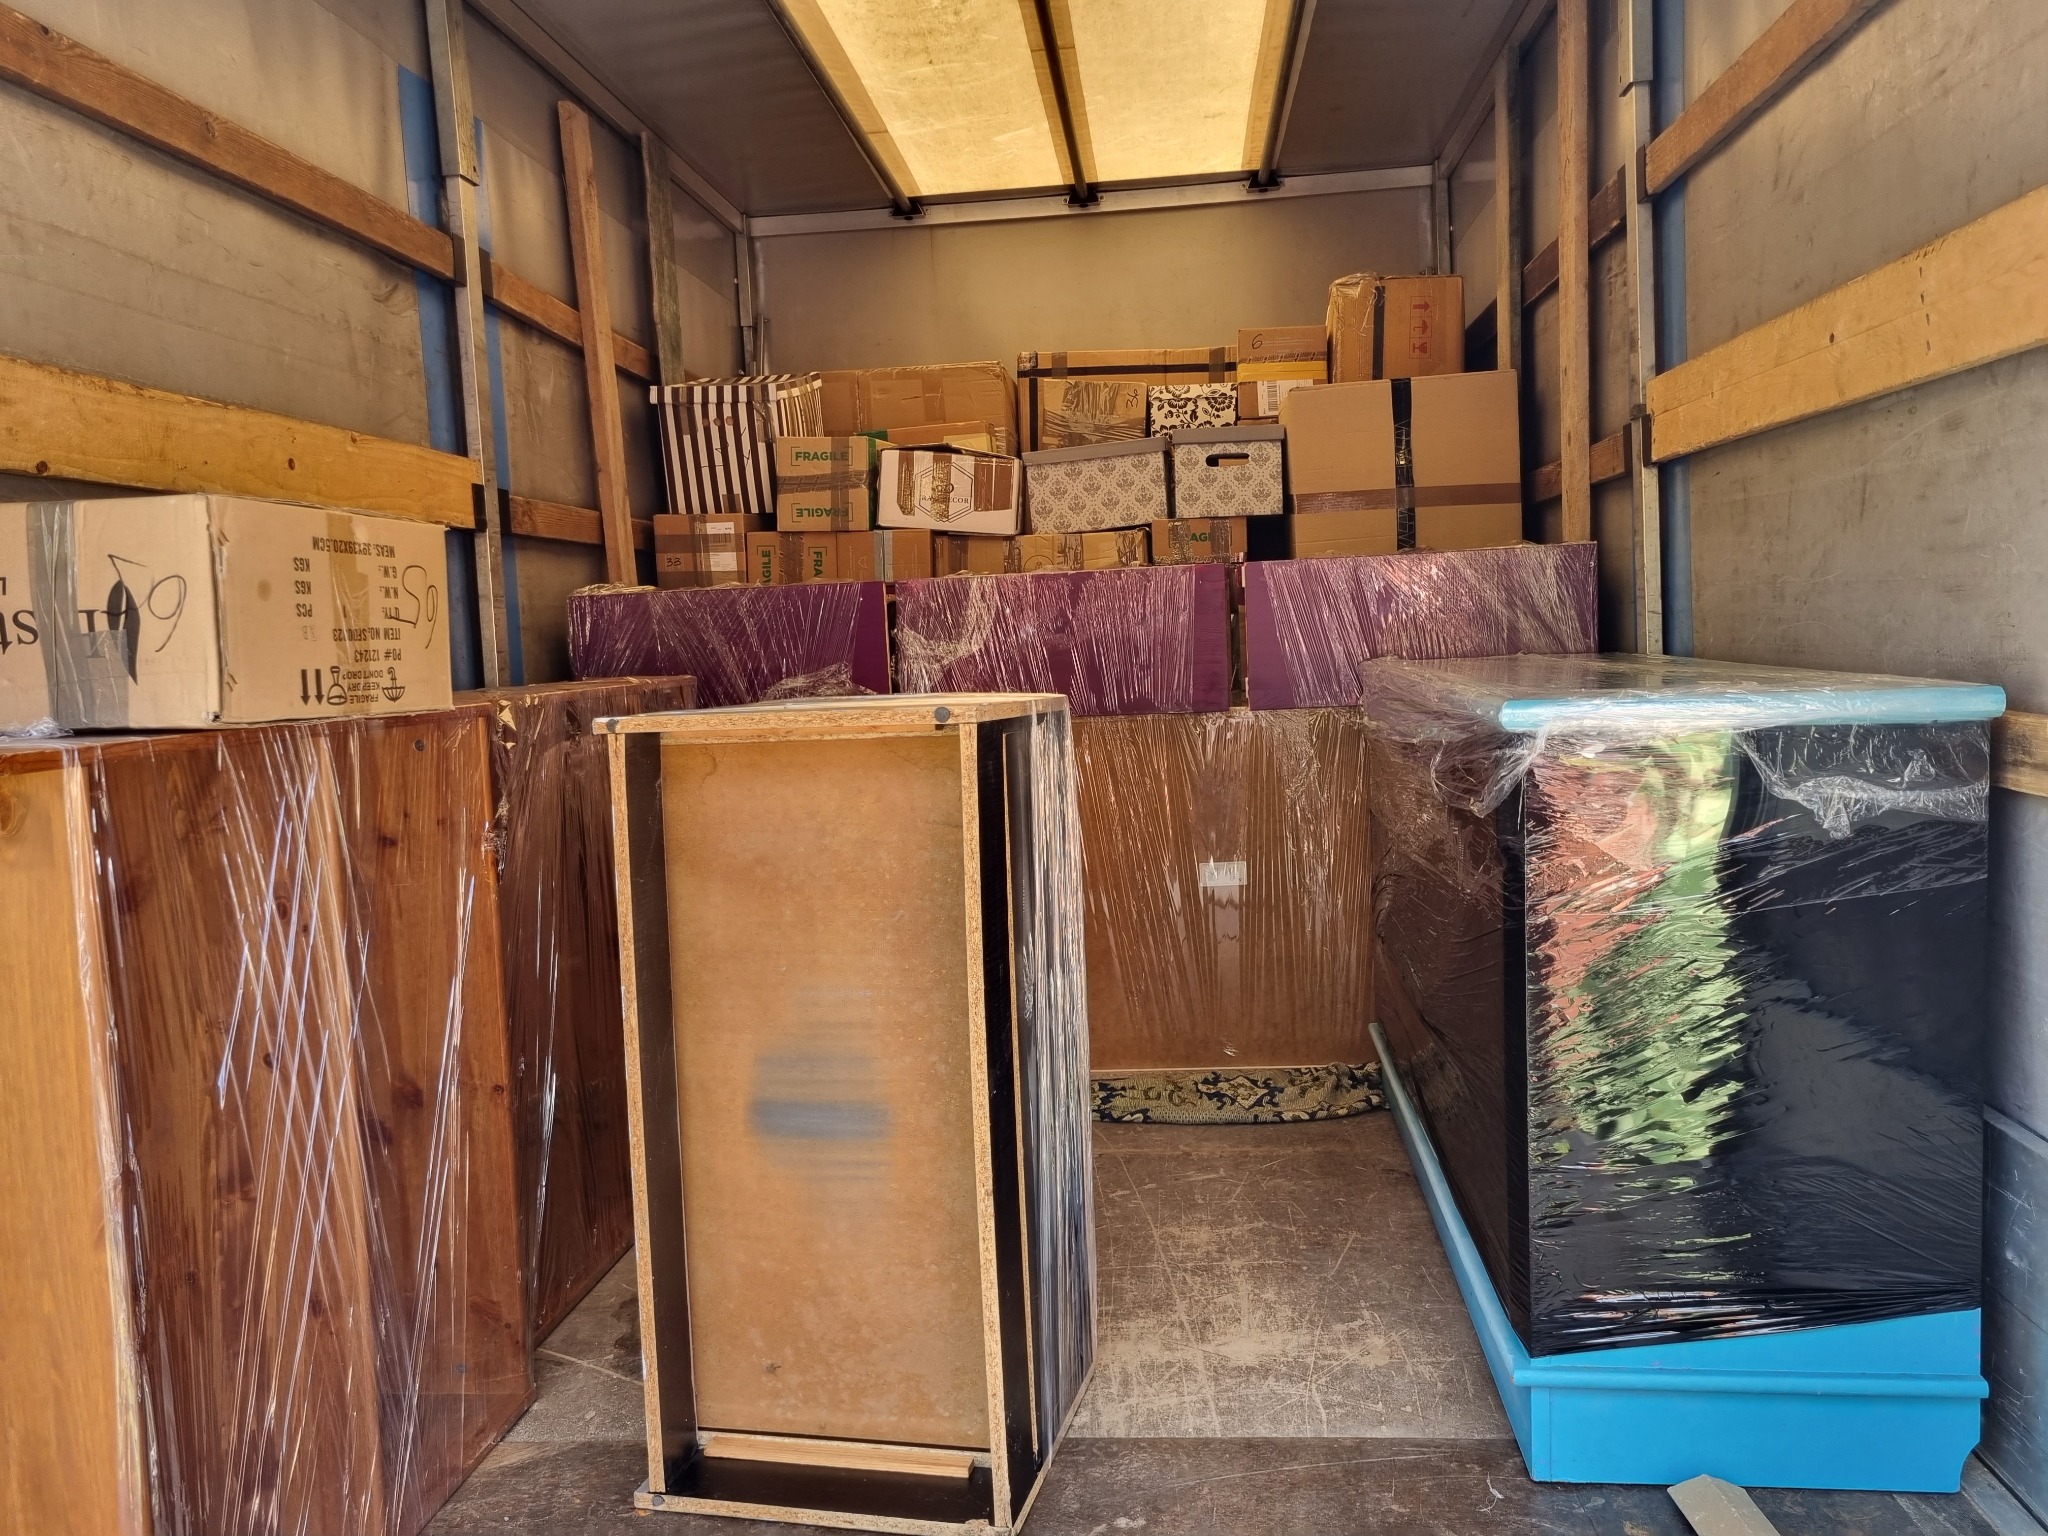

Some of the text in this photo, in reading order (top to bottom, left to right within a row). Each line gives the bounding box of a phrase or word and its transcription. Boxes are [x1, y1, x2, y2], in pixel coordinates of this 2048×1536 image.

[1251, 333, 1263, 350] 6
[795, 451, 850, 461] FRAGILE
[795, 508, 850, 518] FRAGILE
[293, 557, 311, 572] KGS
[666, 557, 682, 568] 33
[295, 580, 399, 600] N.W.: KGS
[296, 603, 313, 618] PCS
[384, 627, 401, 641] ITEM
[354, 649, 380, 663] 121243
[342, 670, 362, 681] DROP
[346, 681, 380, 692] KEEP DRY
[349, 693, 379, 704] FRAGILE
